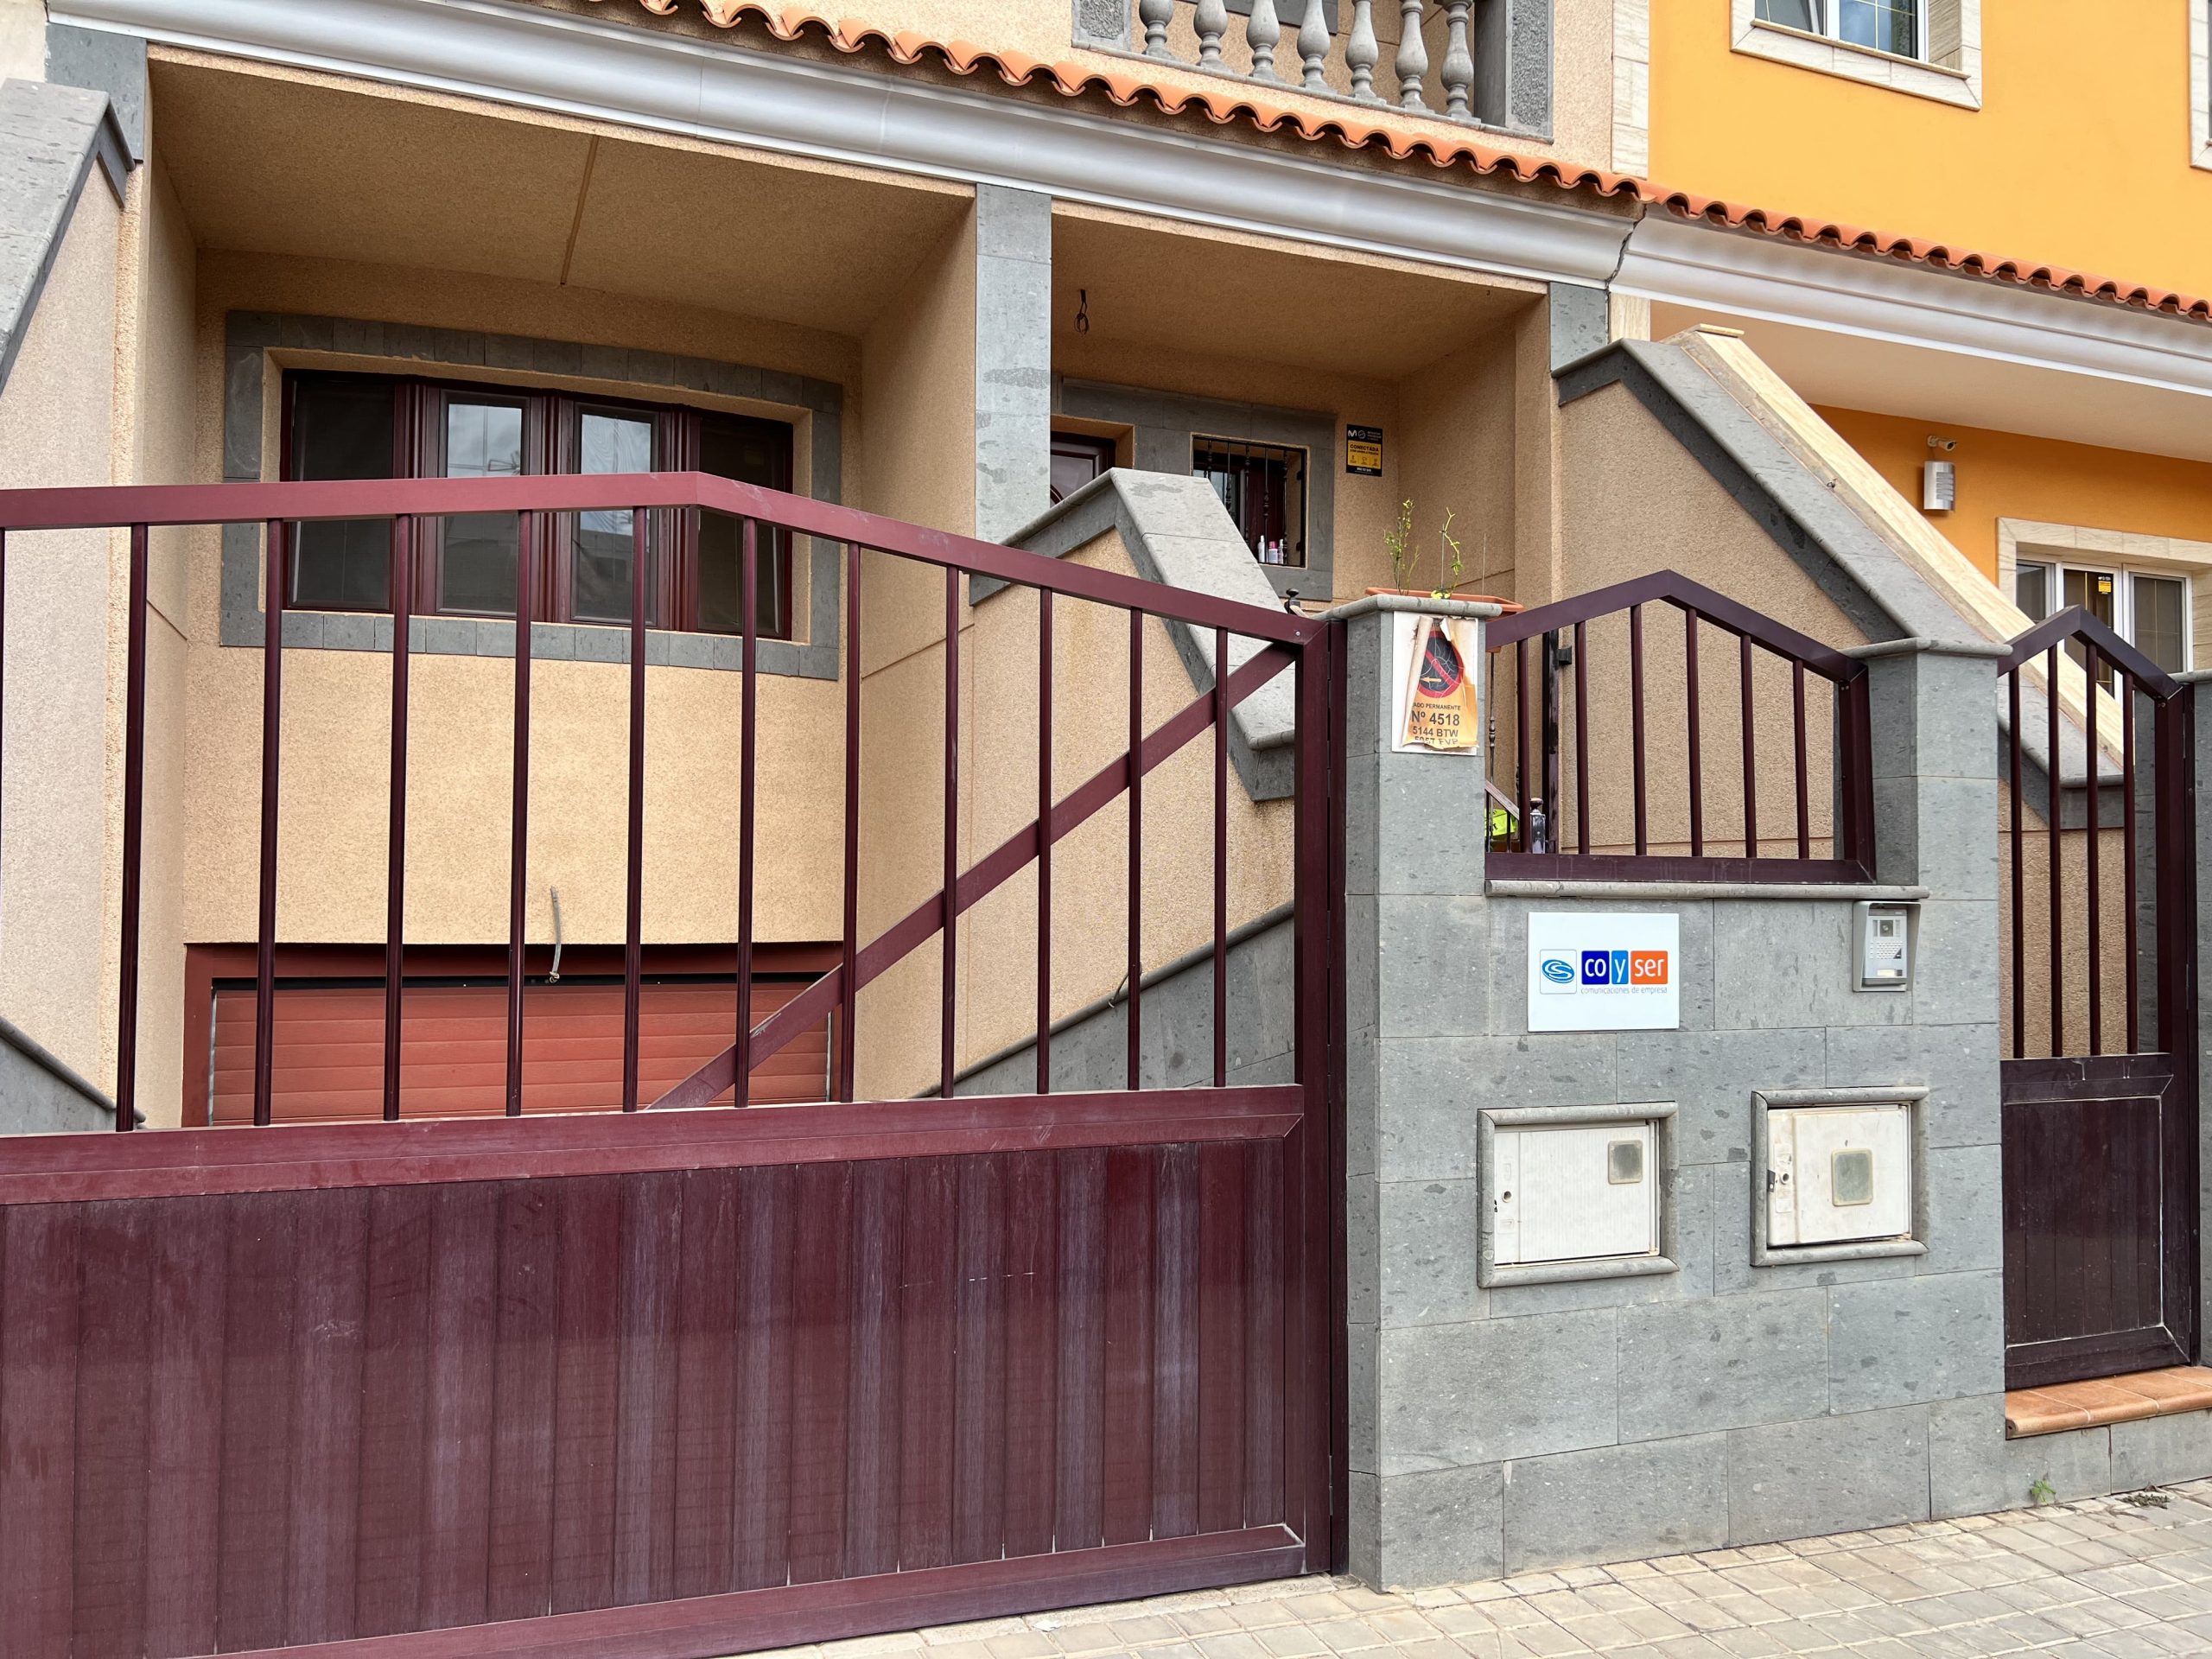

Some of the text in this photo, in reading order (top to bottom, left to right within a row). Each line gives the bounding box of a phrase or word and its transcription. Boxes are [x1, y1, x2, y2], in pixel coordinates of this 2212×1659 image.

[1350, 443, 1379, 452] CONECTADA
[1411, 710, 1459, 726] Nº 4518
[1413, 726, 1459, 737] 5144 BTW
[1640, 987, 1668, 995] empresa
